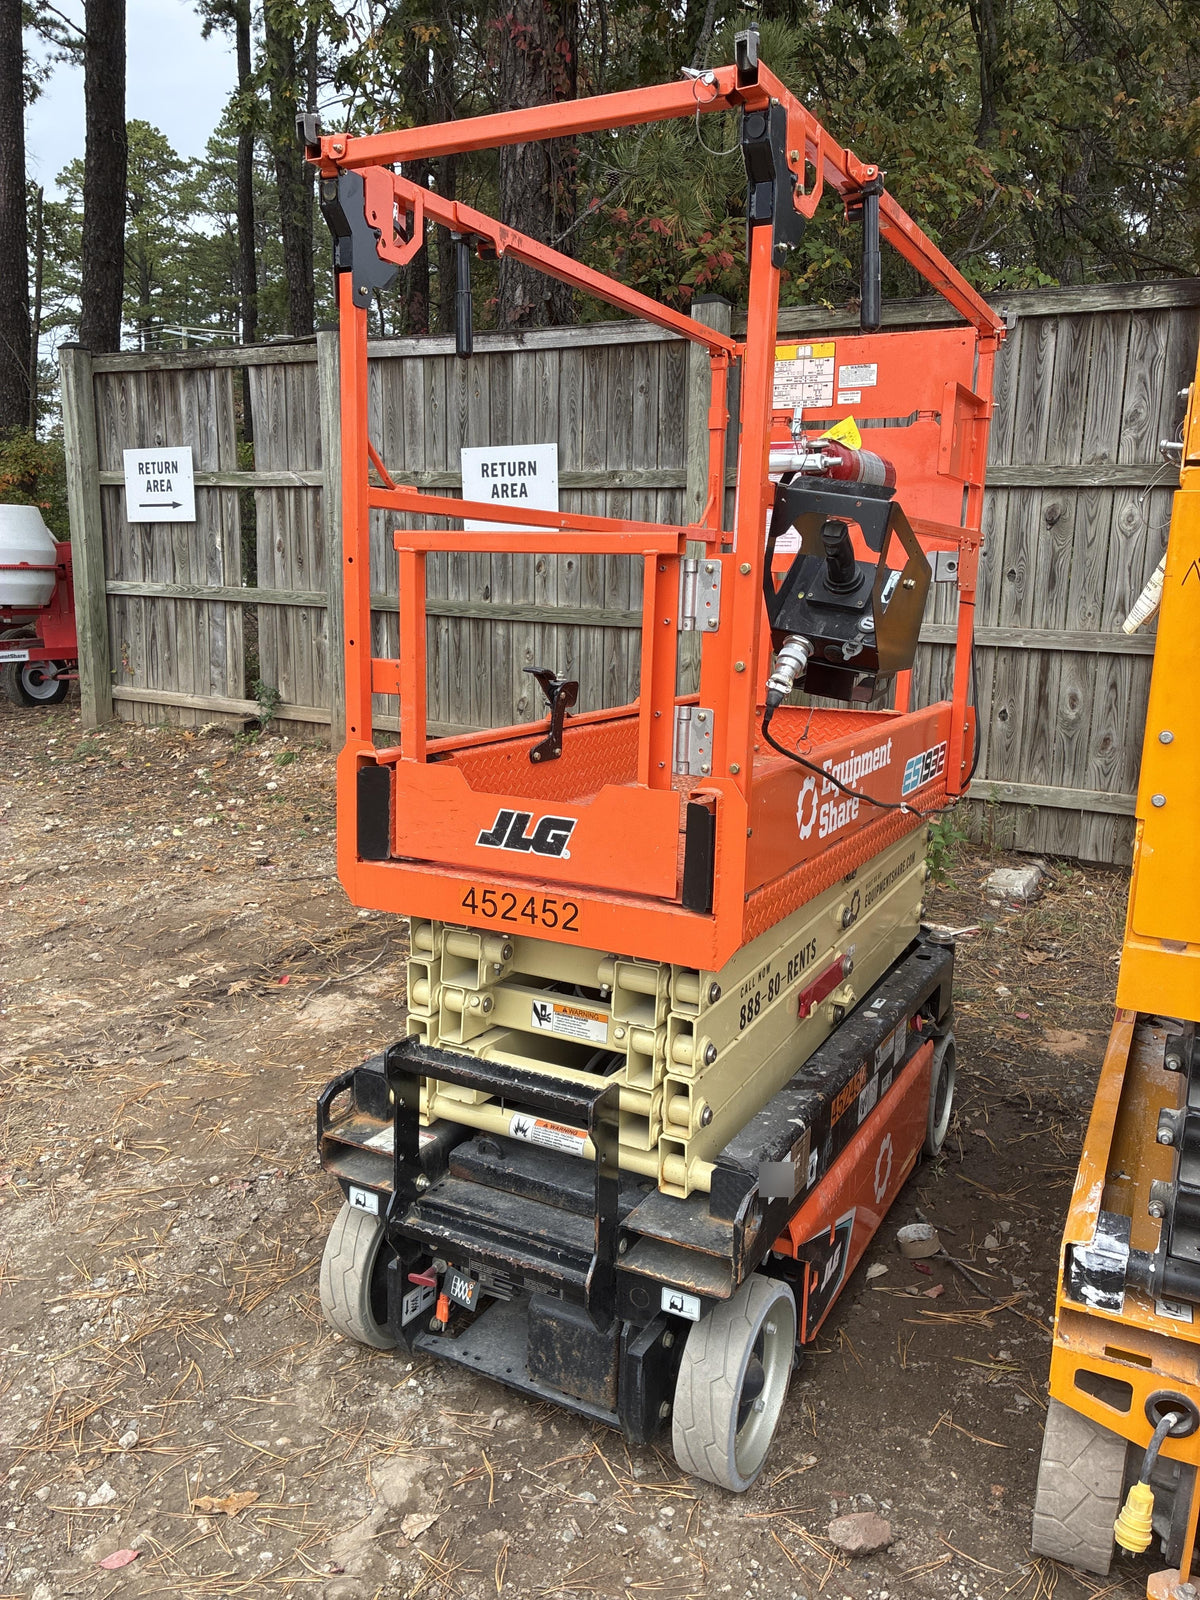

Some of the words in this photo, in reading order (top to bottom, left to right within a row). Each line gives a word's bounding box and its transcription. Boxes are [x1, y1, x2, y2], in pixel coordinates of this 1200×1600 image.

[138, 461, 179, 475] RETURN
[146, 479, 173, 493] AREA
[481, 461, 537, 478] RETURN
[491, 483, 528, 498] AREA
[821, 737, 892, 798] Equipment
[475, 808, 578, 858] JLG
[818, 797, 860, 839] Share
[864, 850, 916, 908] EQUIPMENTSHARE.COM
[462, 887, 579, 932] 452452
[739, 937, 817, 1031] 888-80-RENTS
[740, 978, 756, 998] CALL
[757, 962, 771, 982] NOW
[569, 1007, 599, 1021] WARNING
[550, 1123, 578, 1136] WARNING
[820, 1241, 842, 1294] JLG
